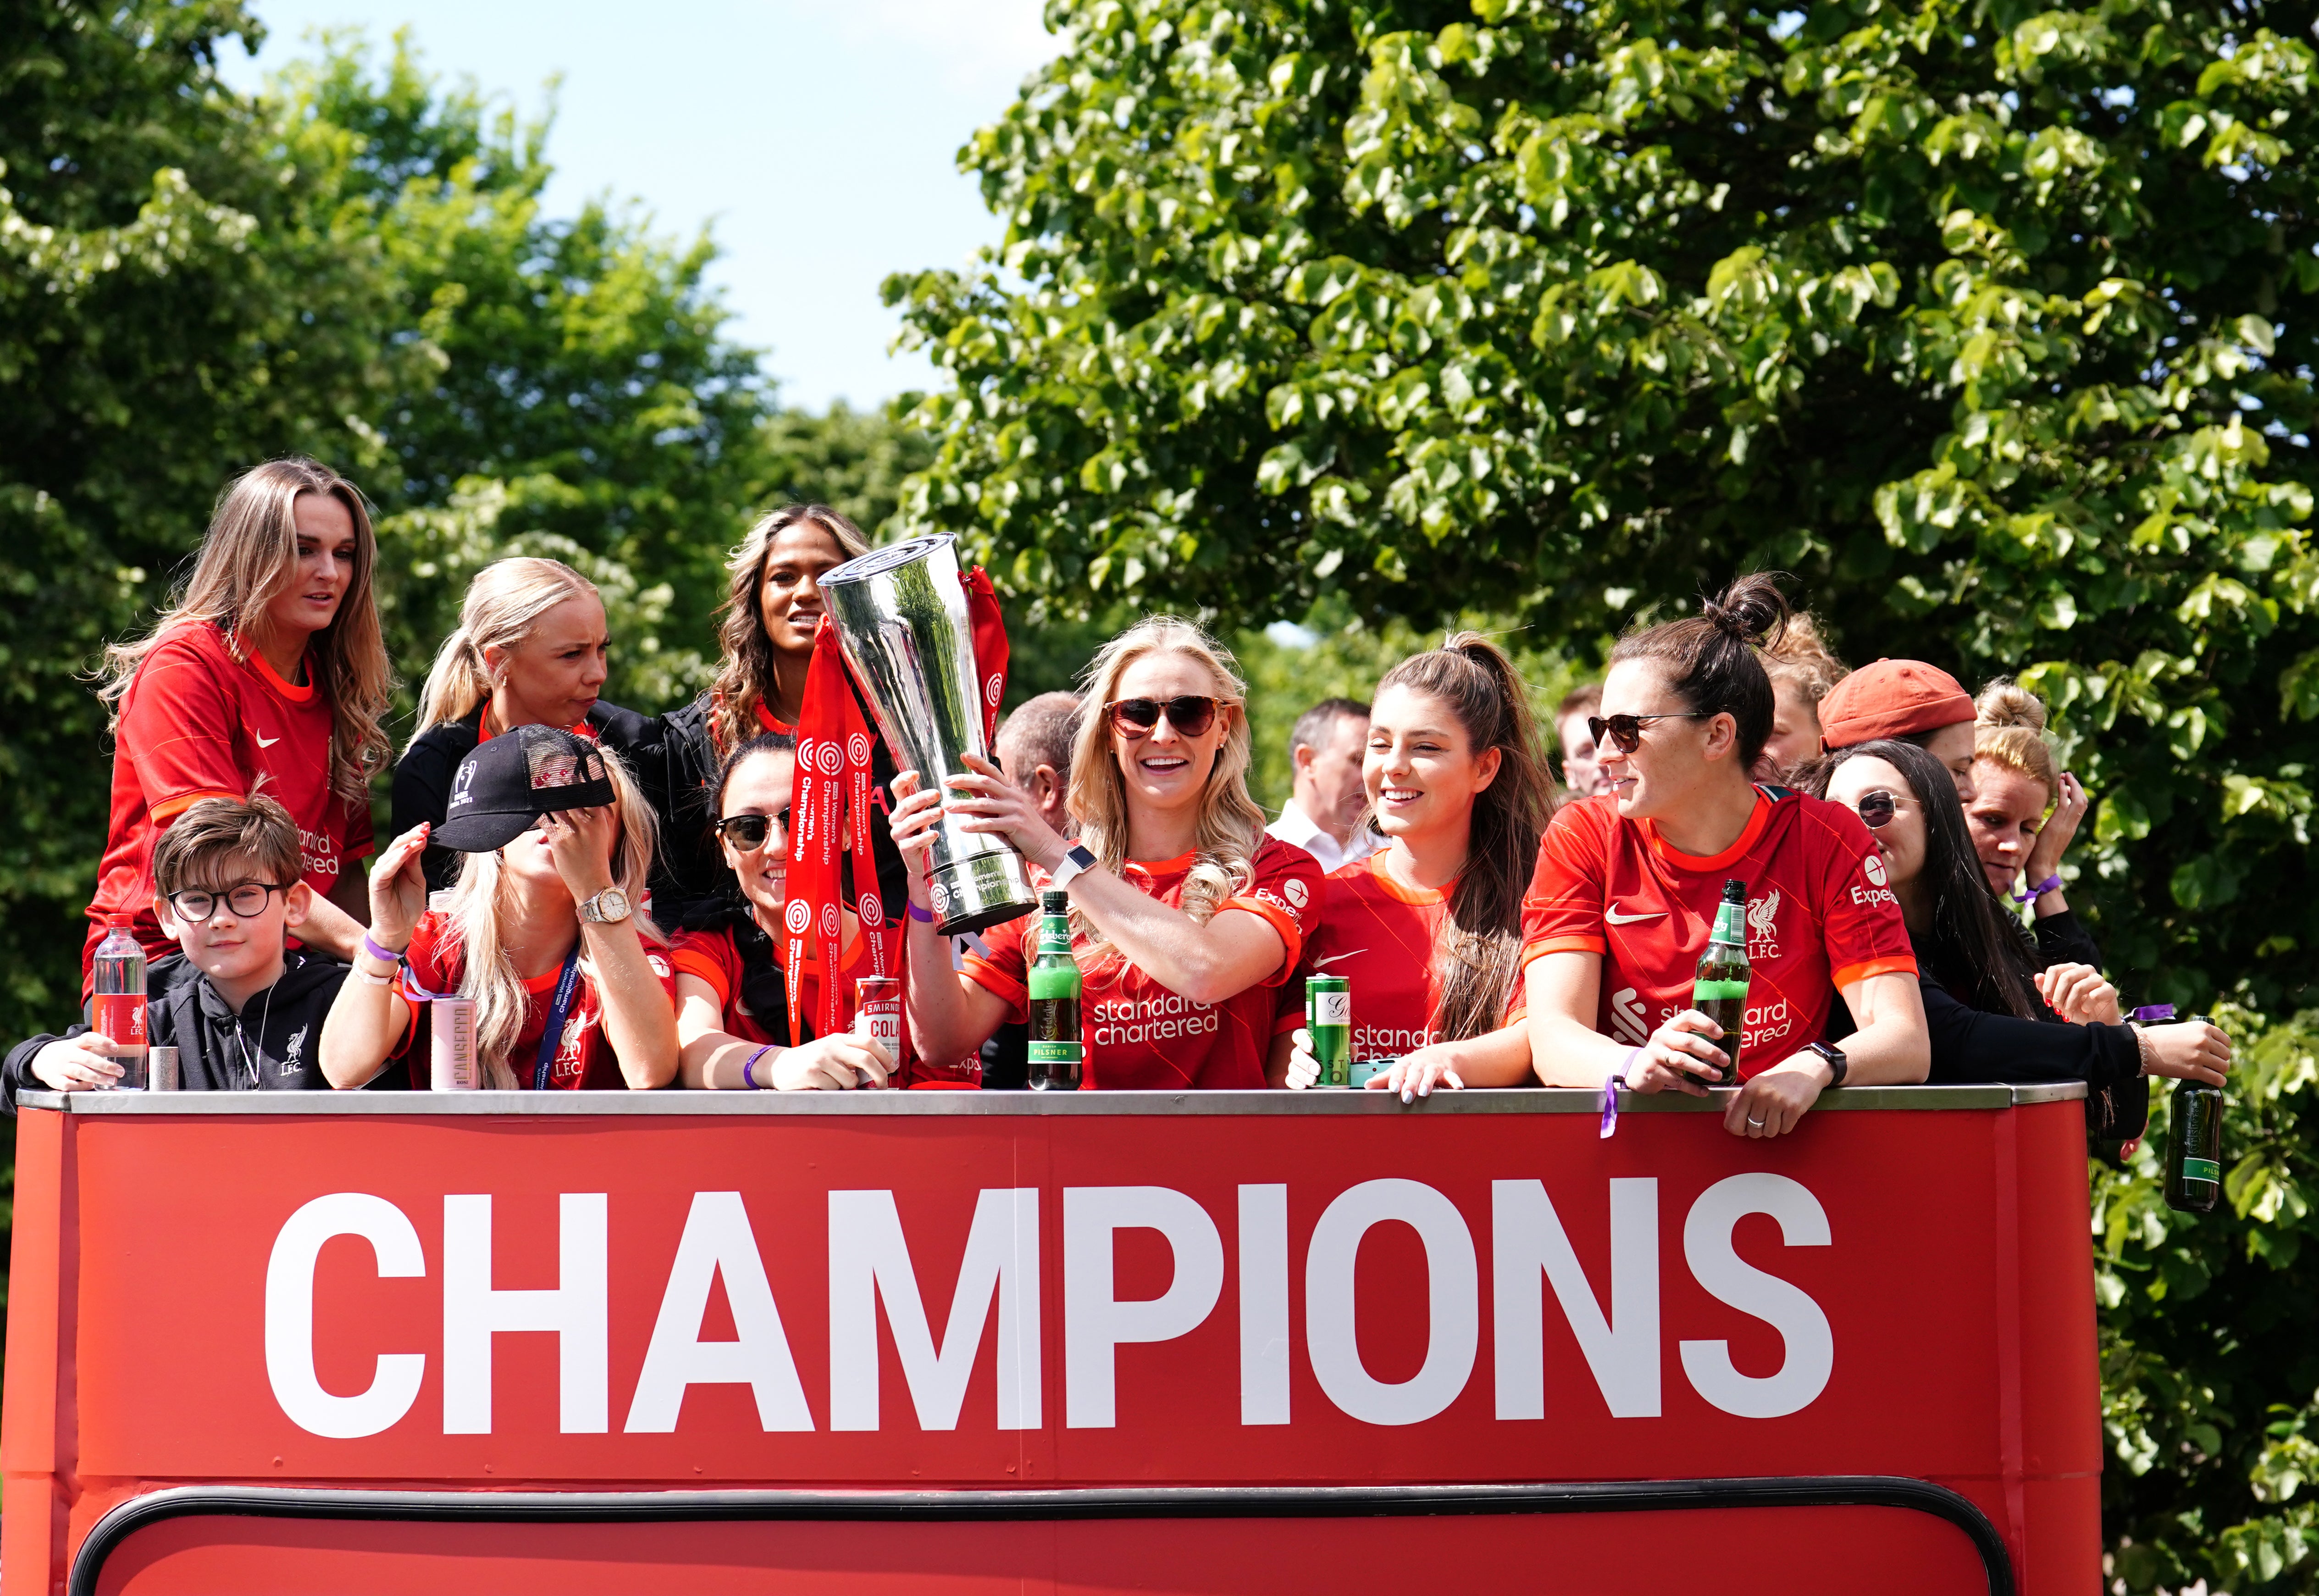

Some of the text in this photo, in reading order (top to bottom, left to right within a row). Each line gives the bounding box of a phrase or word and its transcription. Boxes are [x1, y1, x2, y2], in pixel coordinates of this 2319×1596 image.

[794, 776, 812, 862] Championship
[822, 781, 831, 865] Championship
[854, 772, 863, 855] Championship
[869, 931, 881, 975] Champi
[1749, 944, 1782, 959] L.F.C.
[559, 968, 570, 993] Women's
[871, 1020, 899, 1037] COLA
[1095, 1009, 1218, 1045] chartered
[281, 1062, 302, 1076] L.F.C.
[555, 1062, 583, 1077] L.F.C.
[265, 1173, 1833, 1439] CHAMPIONS
